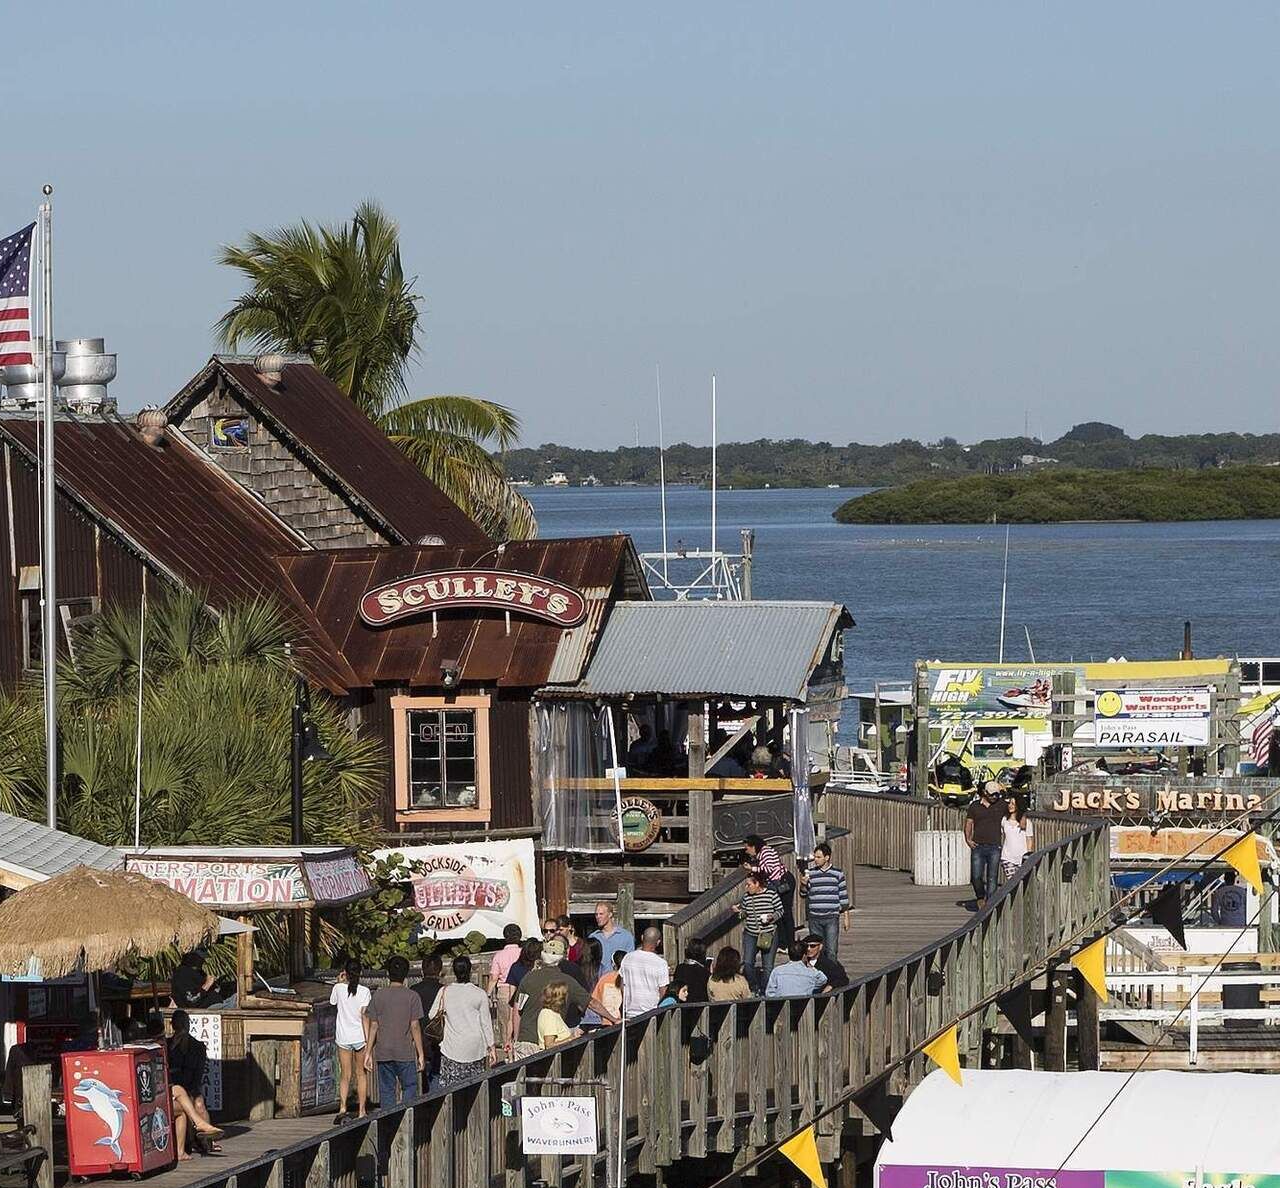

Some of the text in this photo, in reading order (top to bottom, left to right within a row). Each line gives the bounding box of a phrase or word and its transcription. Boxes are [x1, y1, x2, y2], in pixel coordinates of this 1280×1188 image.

[376, 577, 571, 614] SCULLEY'S
[930, 691, 969, 702] HIGH
[1099, 732, 1184, 743] PARASAIL
[1053, 787, 1263, 812] Jack's Marina
[426, 912, 464, 930] GRILLE
